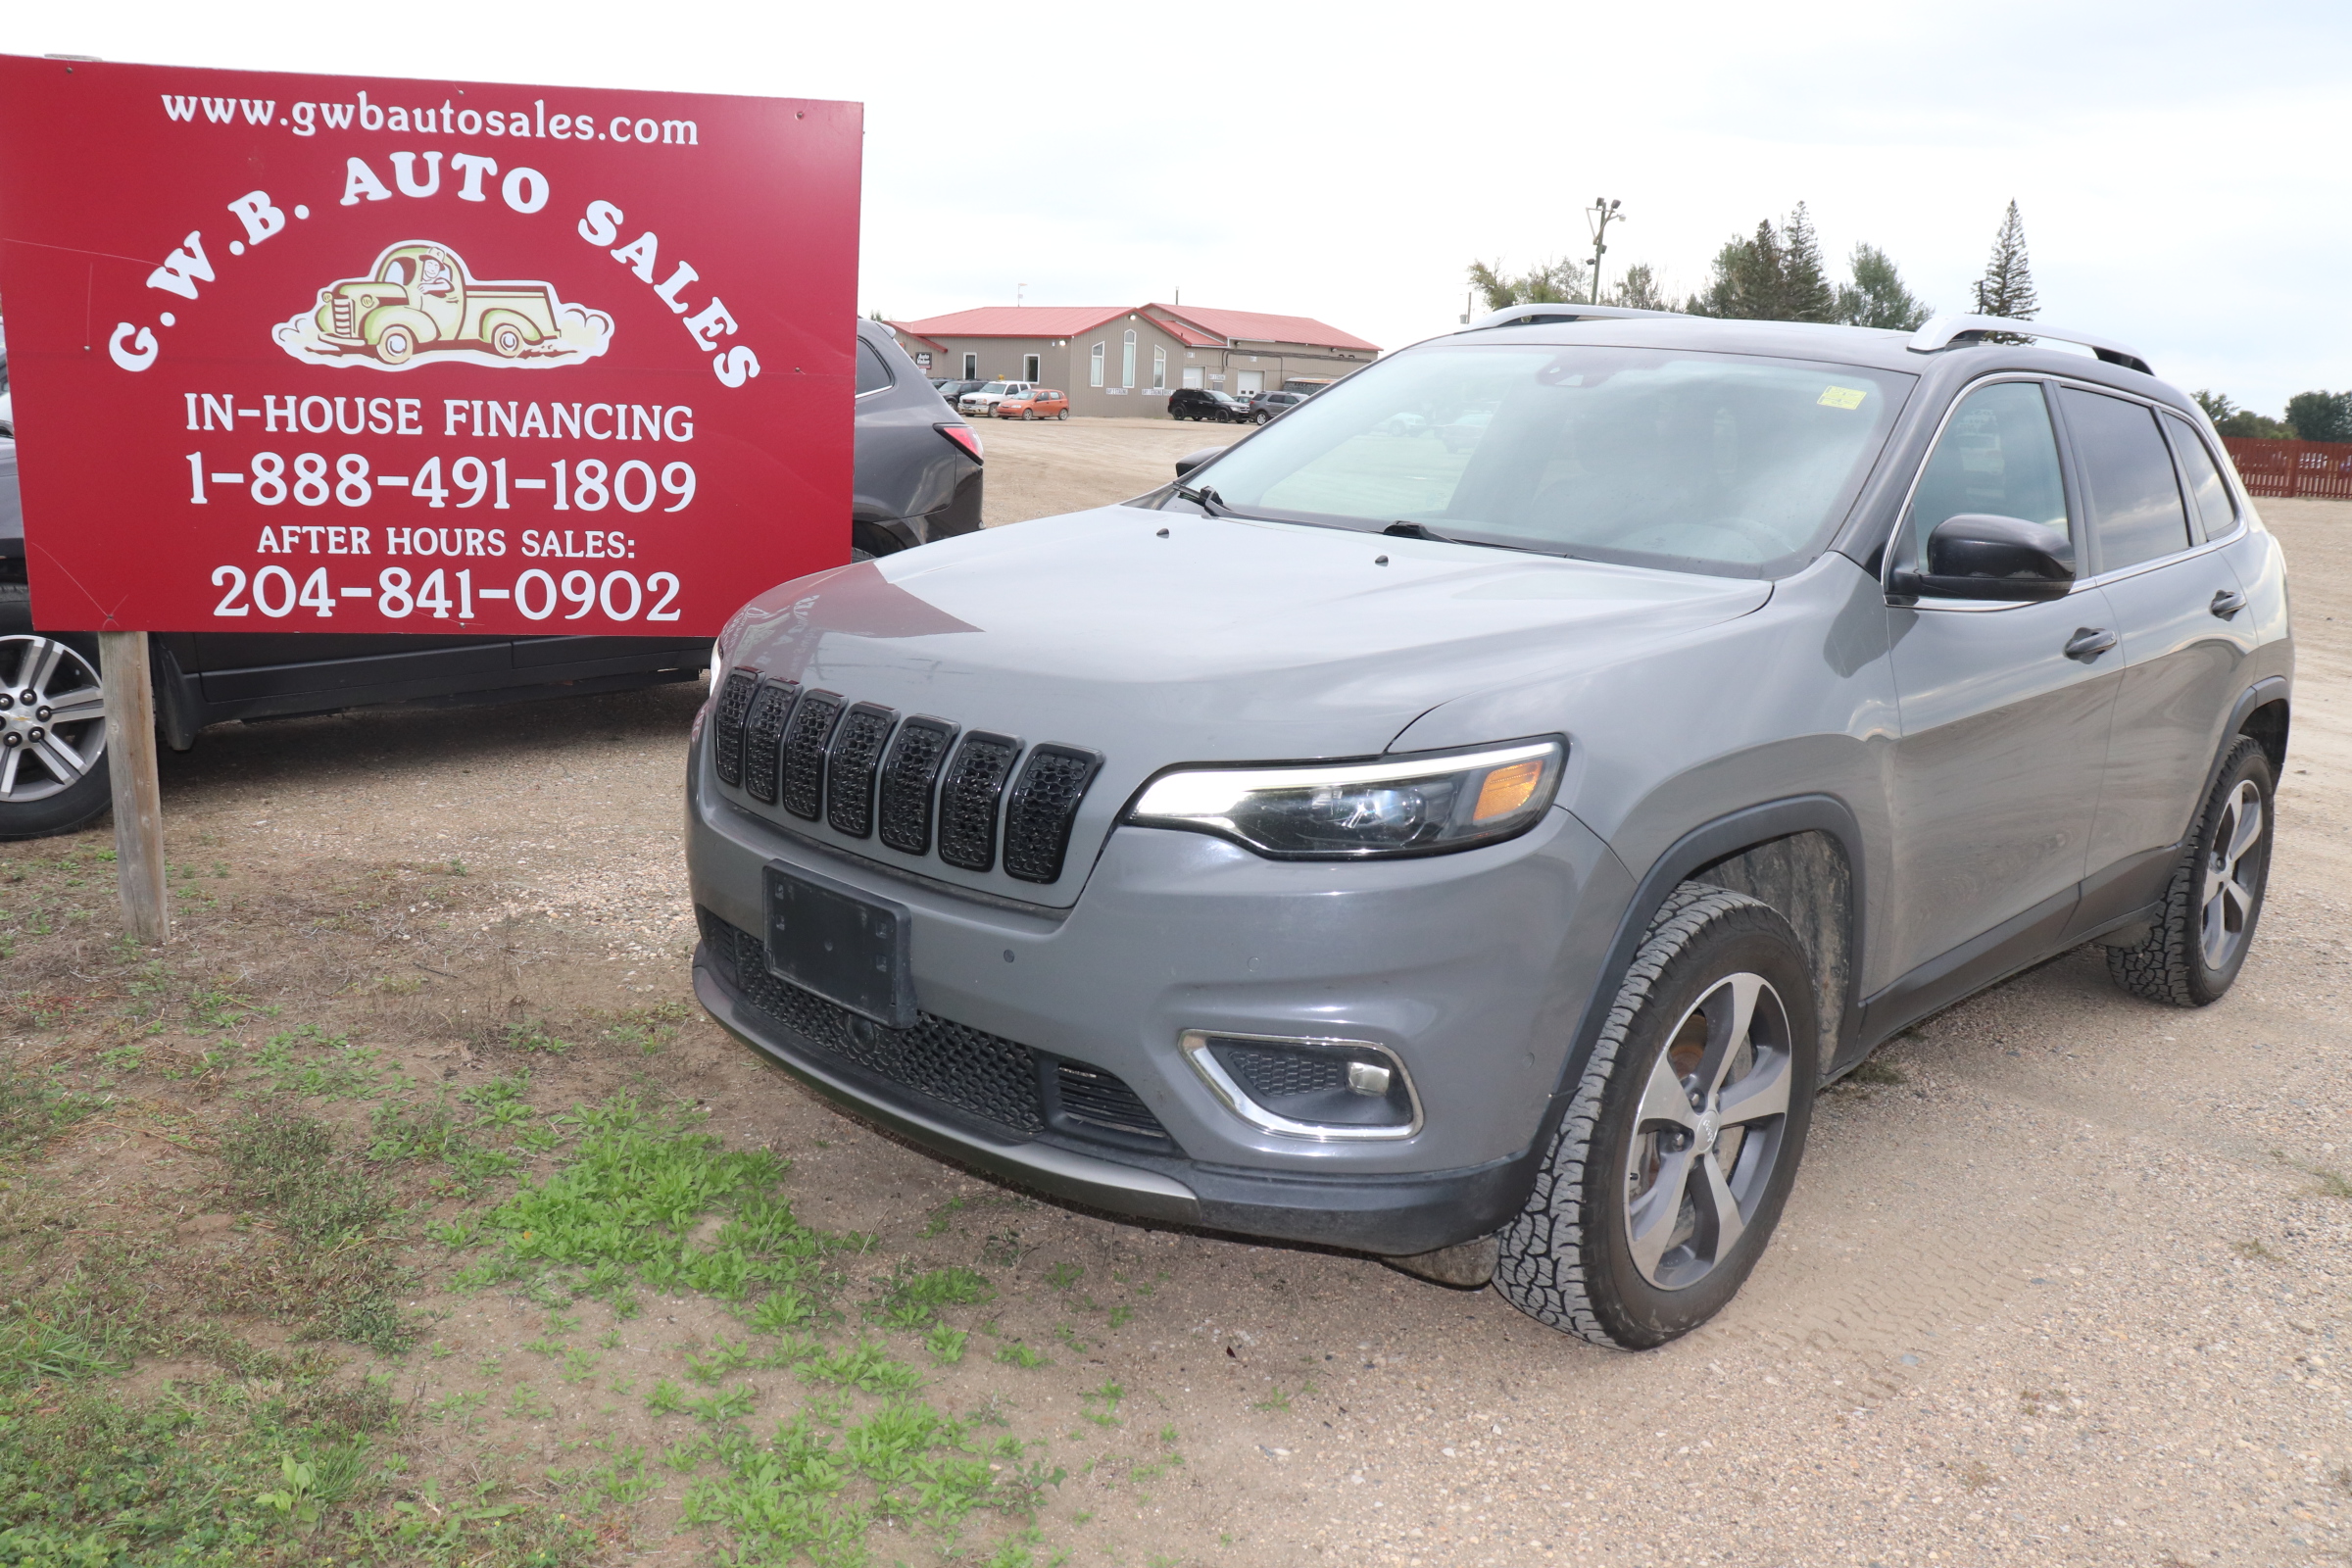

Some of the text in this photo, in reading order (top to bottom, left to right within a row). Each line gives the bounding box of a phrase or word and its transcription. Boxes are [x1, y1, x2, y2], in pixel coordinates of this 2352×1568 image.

[161, 91, 699, 146] www.gwbautosales.com
[339, 150, 550, 215] AUTO
[577, 199, 761, 389] SALES
[183, 392, 694, 443] IN-HOUSE FINANCING
[185, 451, 697, 514] 1-888-491-1809
[256, 525, 636, 560] AFTER HOURS SALES:
[211, 564, 681, 622] 204-841-0902
